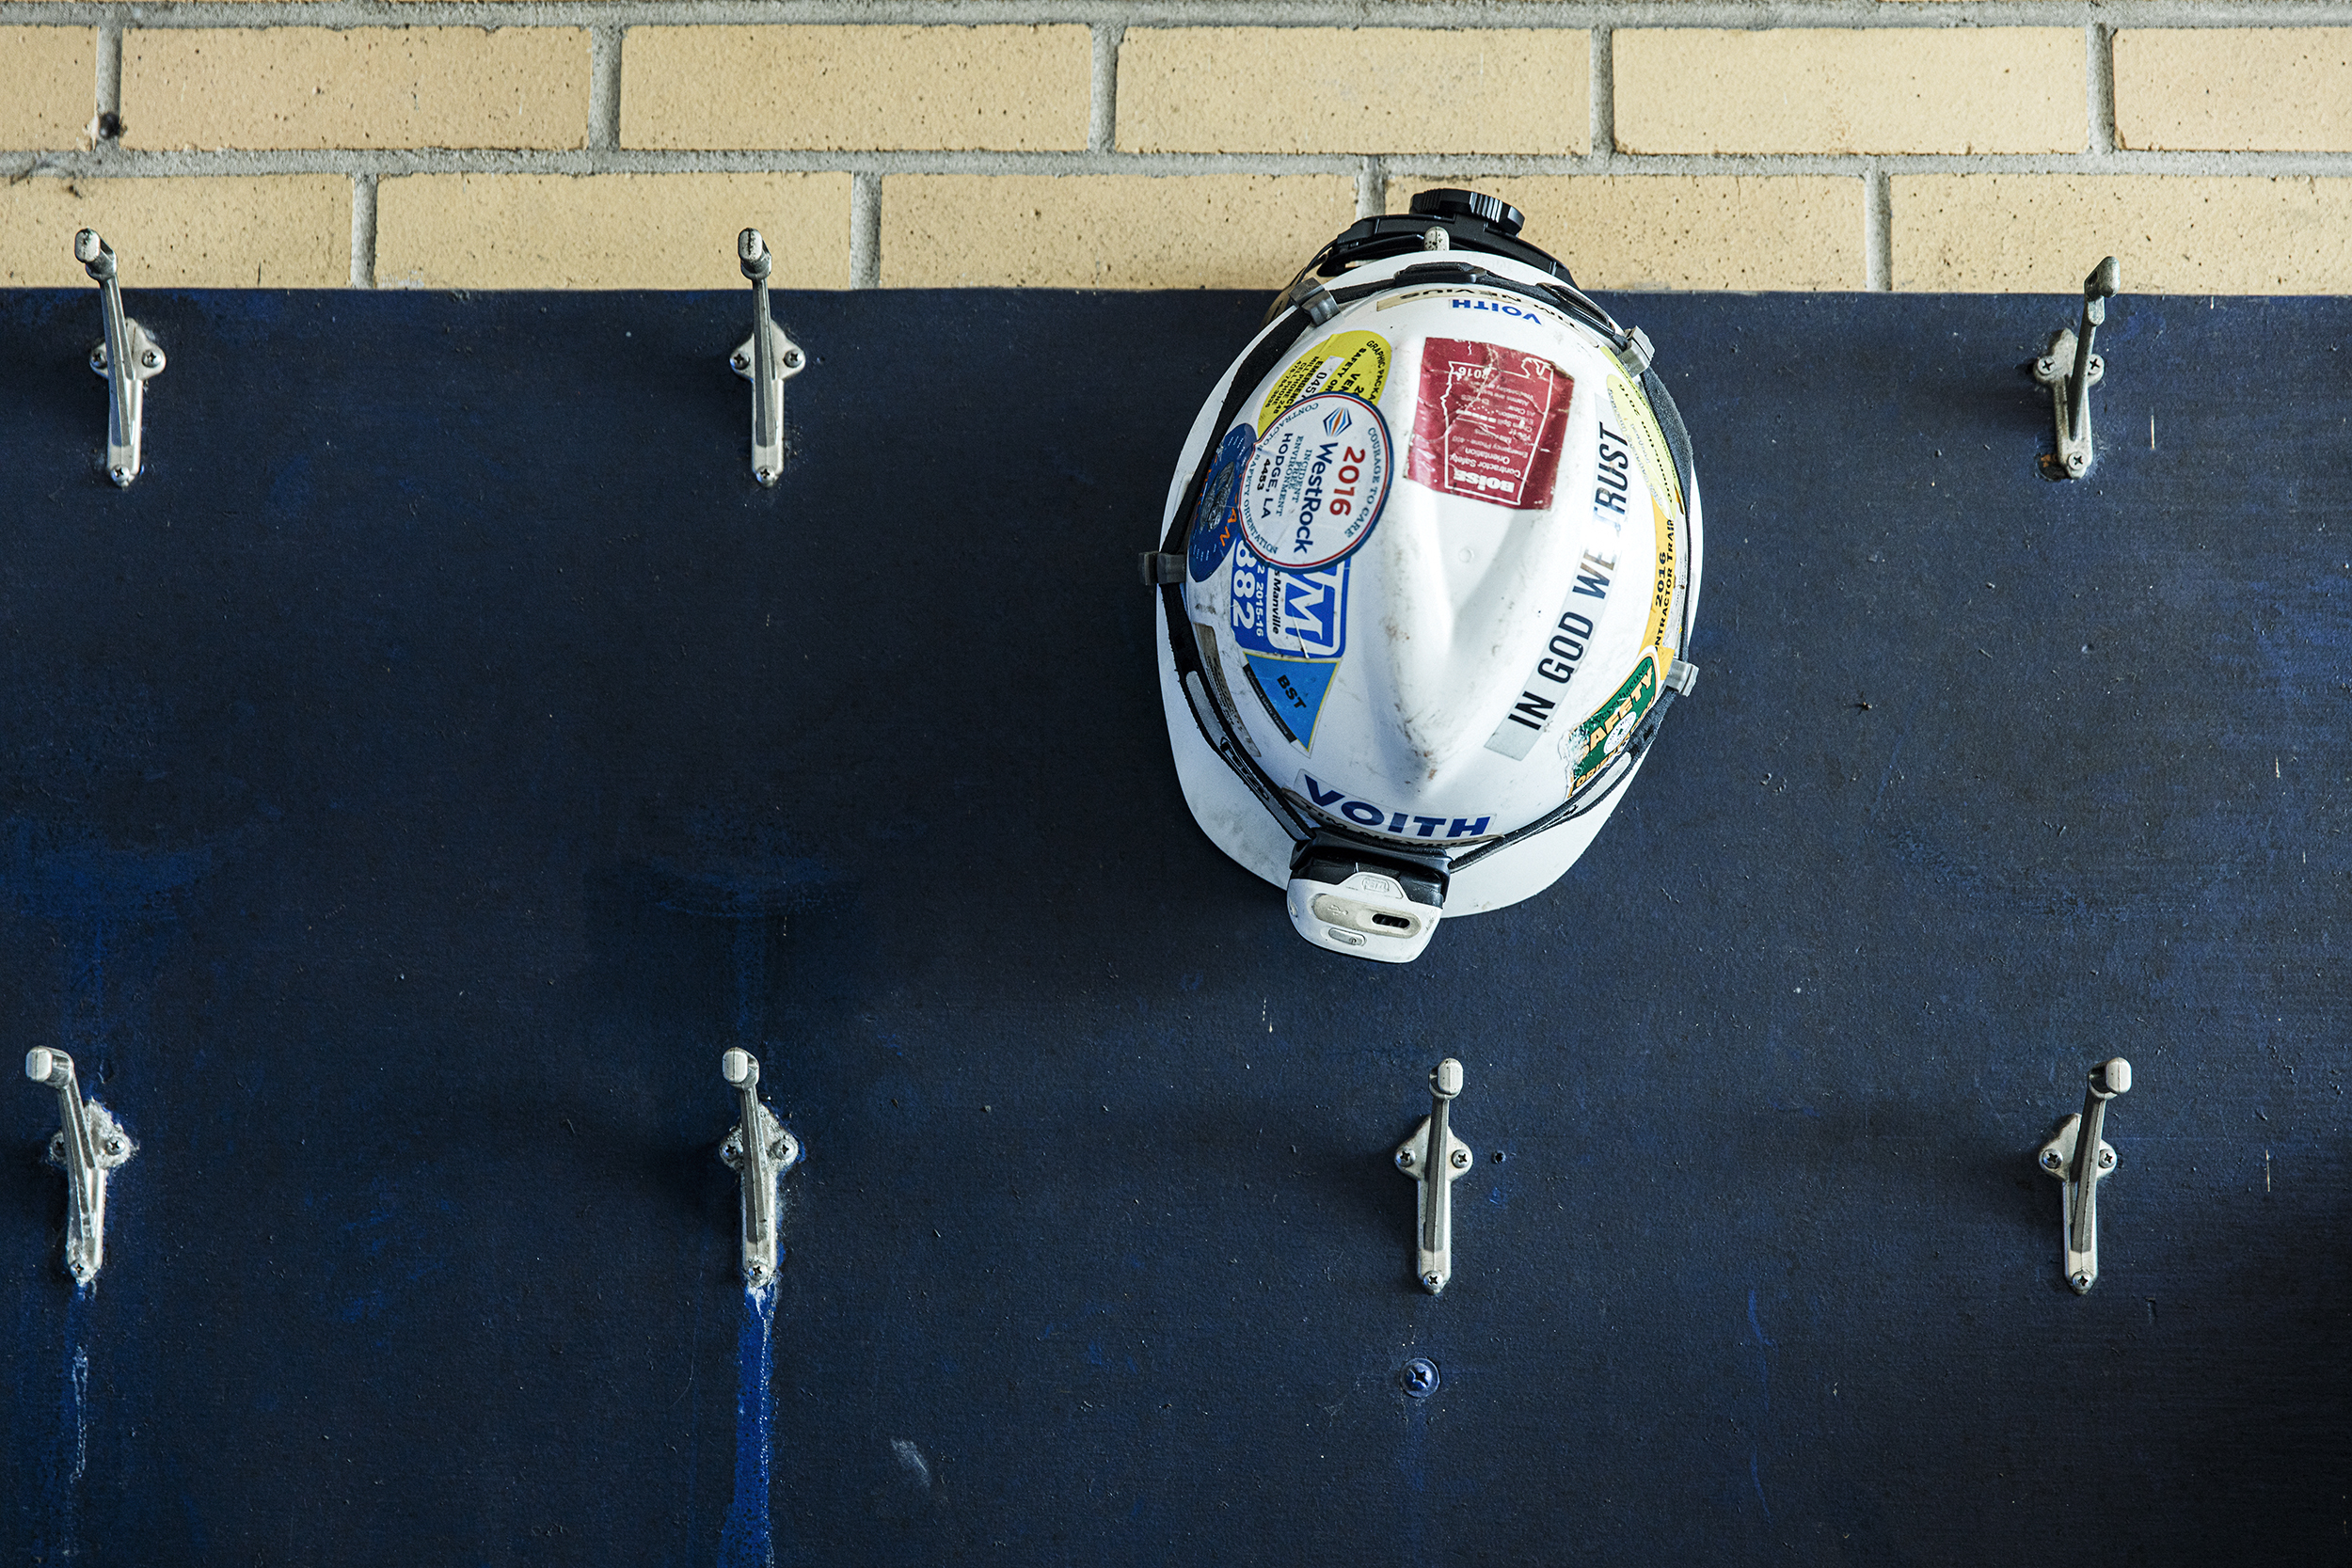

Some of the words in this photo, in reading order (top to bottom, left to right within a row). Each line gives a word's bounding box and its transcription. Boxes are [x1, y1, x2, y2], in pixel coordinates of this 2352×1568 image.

[1452, 298, 1541, 325] VOITH
[1290, 362, 1307, 379] CELL
[1301, 356, 1319, 371] MILL
[1338, 348, 1366, 378] SAFETY
[1366, 340, 1386, 369] GRAPHIC
[1457, 366, 1486, 379] 2016
[1271, 380, 1292, 406] PHONE
[1282, 373, 1304, 397] PHONE
[1285, 360, 1325, 410] EMERGENCY
[1368, 368, 1386, 405] PACKA
[1256, 403, 1319, 453] CONTRACTOR
[1506, 404, 1526, 415] Clear
[1268, 433, 1294, 492] HODGE,
[1368, 427, 1380, 483] COURAGE
[1448, 451, 1476, 467] Safety
[1464, 446, 1510, 465] Orientation
[1470, 438, 1492, 450] Phone
[1491, 442, 1528, 457] Emergency
[1244, 453, 1262, 497] SAFETY
[1257, 458, 1271, 491] 4453
[1276, 436, 1304, 516] ENVIRONMENT
[1288, 460, 1303, 490] FREE
[1294, 449, 1312, 503] INCIDENT
[1329, 446, 1366, 515] 2016
[1477, 459, 1521, 476] Contractor
[1589, 421, 1628, 536] TRUST
[1261, 498, 1274, 518] LA
[1294, 442, 1339, 553] WestRock
[1366, 486, 1378, 505] TO
[1243, 499, 1278, 555] ORIENTATION
[1344, 507, 1370, 538] CARE
[1232, 540, 1256, 627] 882
[1571, 547, 1618, 597] WE
[1654, 550, 1666, 607] 2016
[1255, 581, 1263, 636] 2015-16
[1272, 578, 1280, 634] Manville
[1537, 610, 1595, 684] GOD
[1276, 673, 1307, 708] BST
[1260, 696, 1274, 715] Safety
[1271, 713, 1289, 736] Training
[1508, 690, 1552, 731] IN
[1304, 773, 1490, 837] VOITH
